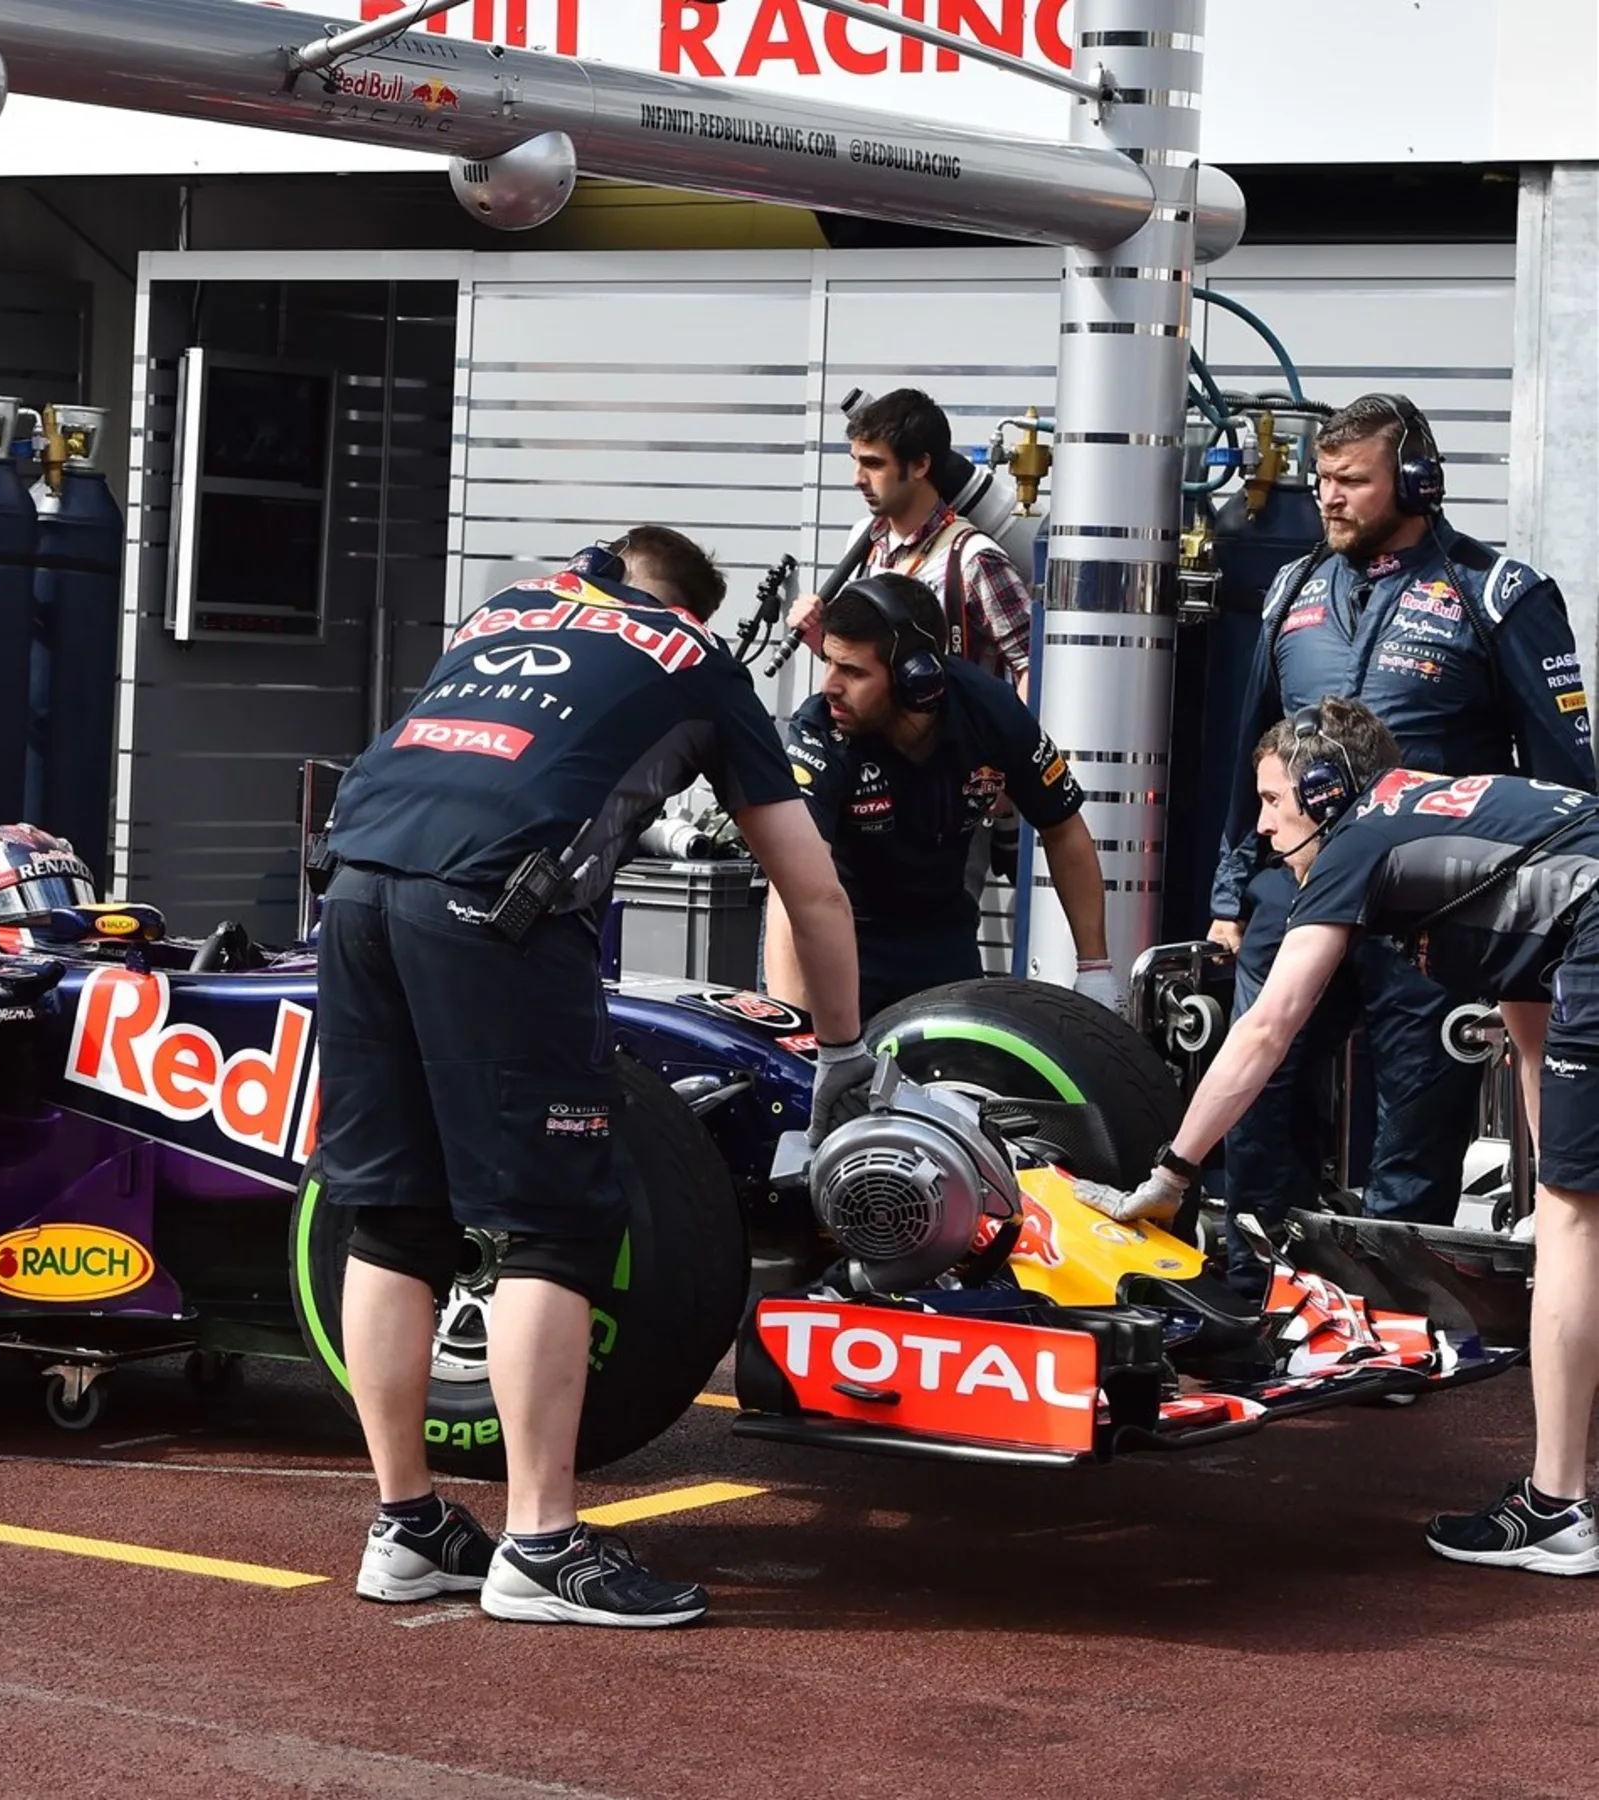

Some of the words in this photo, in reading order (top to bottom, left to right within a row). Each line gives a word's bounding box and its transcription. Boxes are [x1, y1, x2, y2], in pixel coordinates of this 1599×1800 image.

[367, 71, 404, 102] Bull
[317, 101, 455, 133] RACING
[640, 103, 837, 159] INFINITI-REDBULLRACING.COM
[849, 140, 962, 179] @REDBULLRACING
[1401, 592, 1431, 612] Red
[1429, 598, 1462, 622] Bull
[566, 605, 707, 674] Bull
[952, 626, 961, 653] EOS
[1378, 664, 1441, 683] RACING
[424, 683, 573, 720] INFINITI
[411, 722, 513, 753] TOTAL
[852, 801, 892, 814] TOTAL
[107, 919, 135, 930] RAUCH
[64, 965, 313, 1158] Red
[22, 1247, 129, 1277] RAUCH
[760, 1312, 1093, 1410] TOTAL
